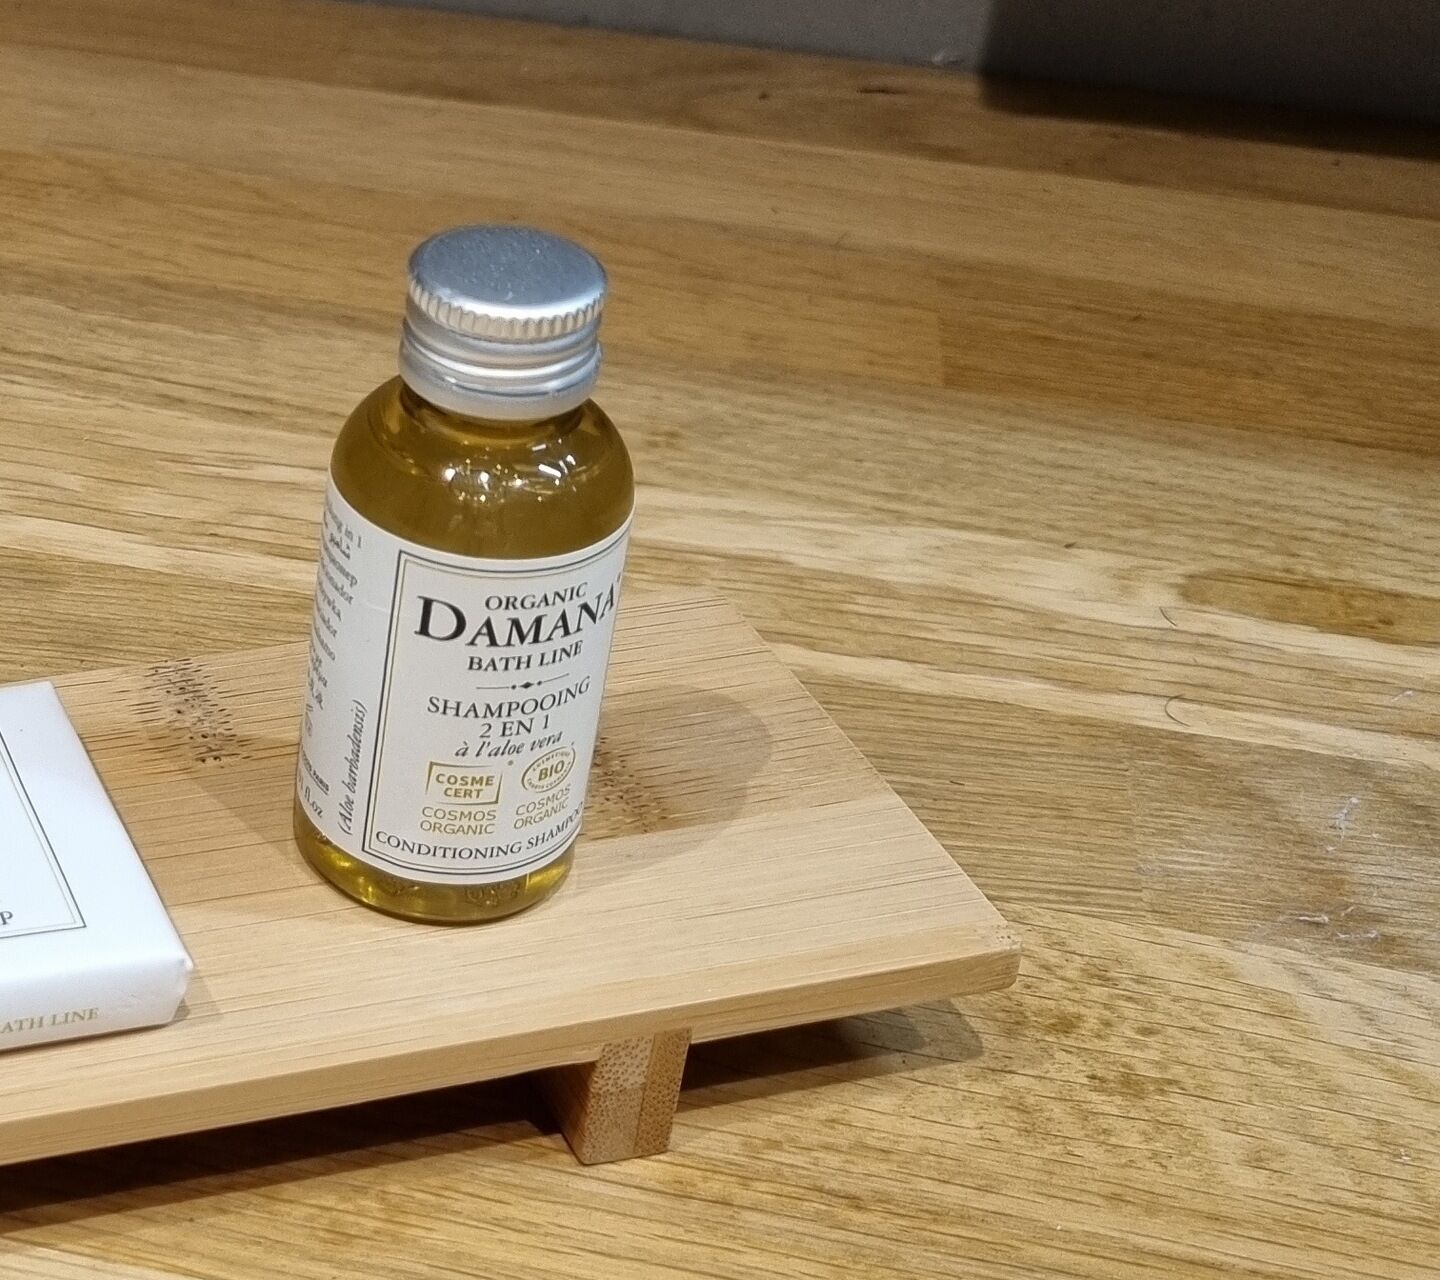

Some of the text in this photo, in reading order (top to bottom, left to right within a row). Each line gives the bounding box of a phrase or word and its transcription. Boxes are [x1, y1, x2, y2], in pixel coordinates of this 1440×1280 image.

[485, 582, 588, 611] ORGANIC
[467, 640, 584, 672] BATH LINE
[427, 675, 591, 719] SHAMPOOING
[479, 714, 551, 738] 2 EN 1
[454, 731, 563, 758] à l'aloe vera
[435, 773, 495, 787] COSME
[537, 759, 565, 782] BIO
[443, 787, 484, 799] CERT
[515, 783, 571, 816] COSMOS
[421, 806, 497, 821] COSMOS
[513, 796, 569, 830] ORGANIC
[420, 820, 496, 835] ORGANIC
[375, 830, 523, 860] CONDITIONING
[50, 1007, 99, 1027] LINE
